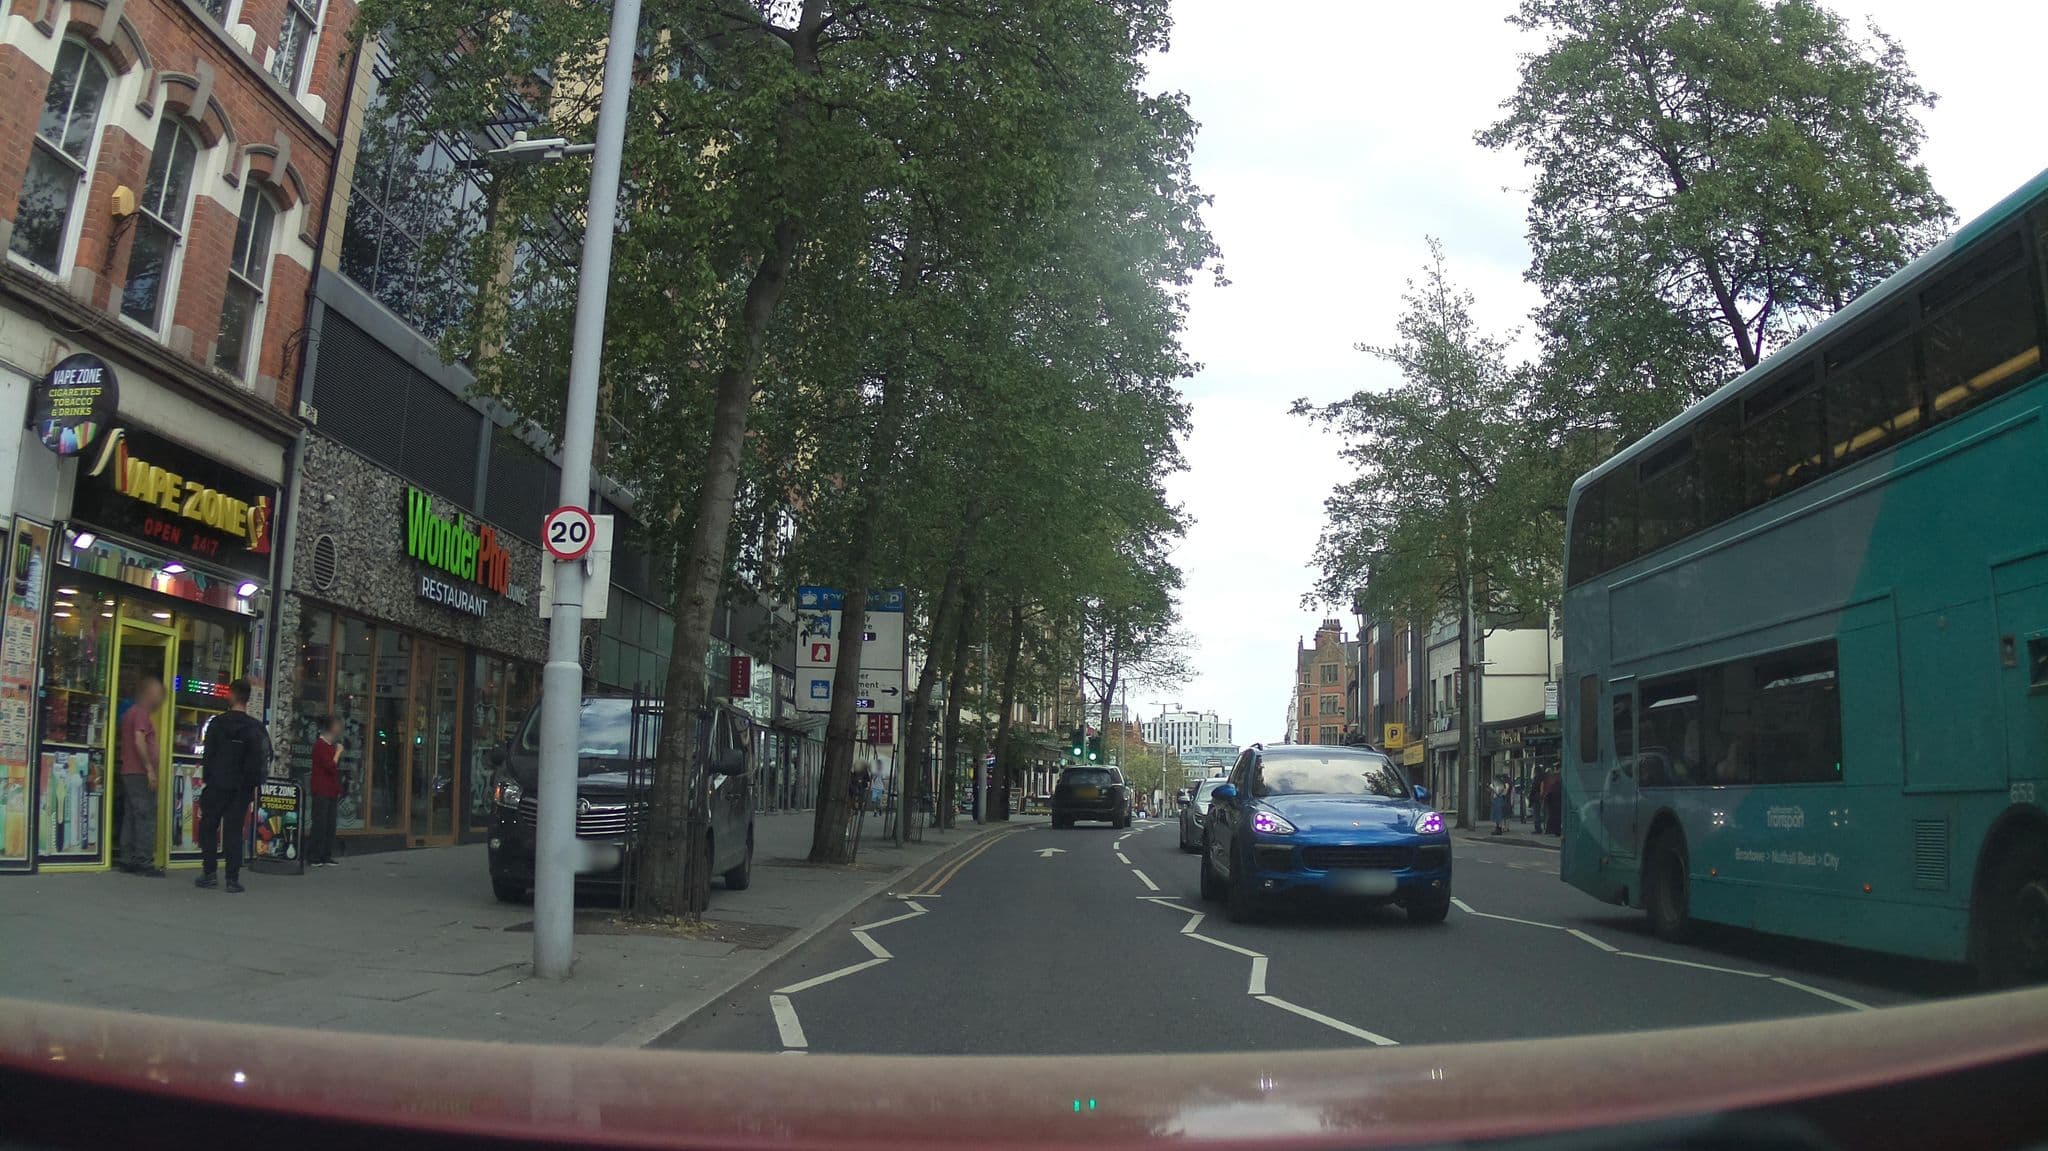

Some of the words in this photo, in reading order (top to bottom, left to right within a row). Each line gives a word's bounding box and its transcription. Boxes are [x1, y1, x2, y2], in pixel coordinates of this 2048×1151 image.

[53, 369, 76, 385] VAPE
[76, 368, 104, 384] ZONE
[48, 387, 102, 397] CIGARETTES
[53, 397, 93, 407] TOBACCO
[58, 407, 92, 416] DRINKS
[127, 457, 183, 513] VAPE
[182, 481, 248, 538] ZONE
[144, 518, 181, 544] OPEN
[551, 521, 587, 543] 20
[422, 576, 489, 617] RESTAURANT
[1391, 729, 1398, 738] P
[261, 784, 278, 796] VAPE
[278, 785, 297, 797] ZONE
[267, 803, 295, 811] TOBACCO
[1797, 851, 1816, 866] Road
[1823, 852, 1840, 872] City
